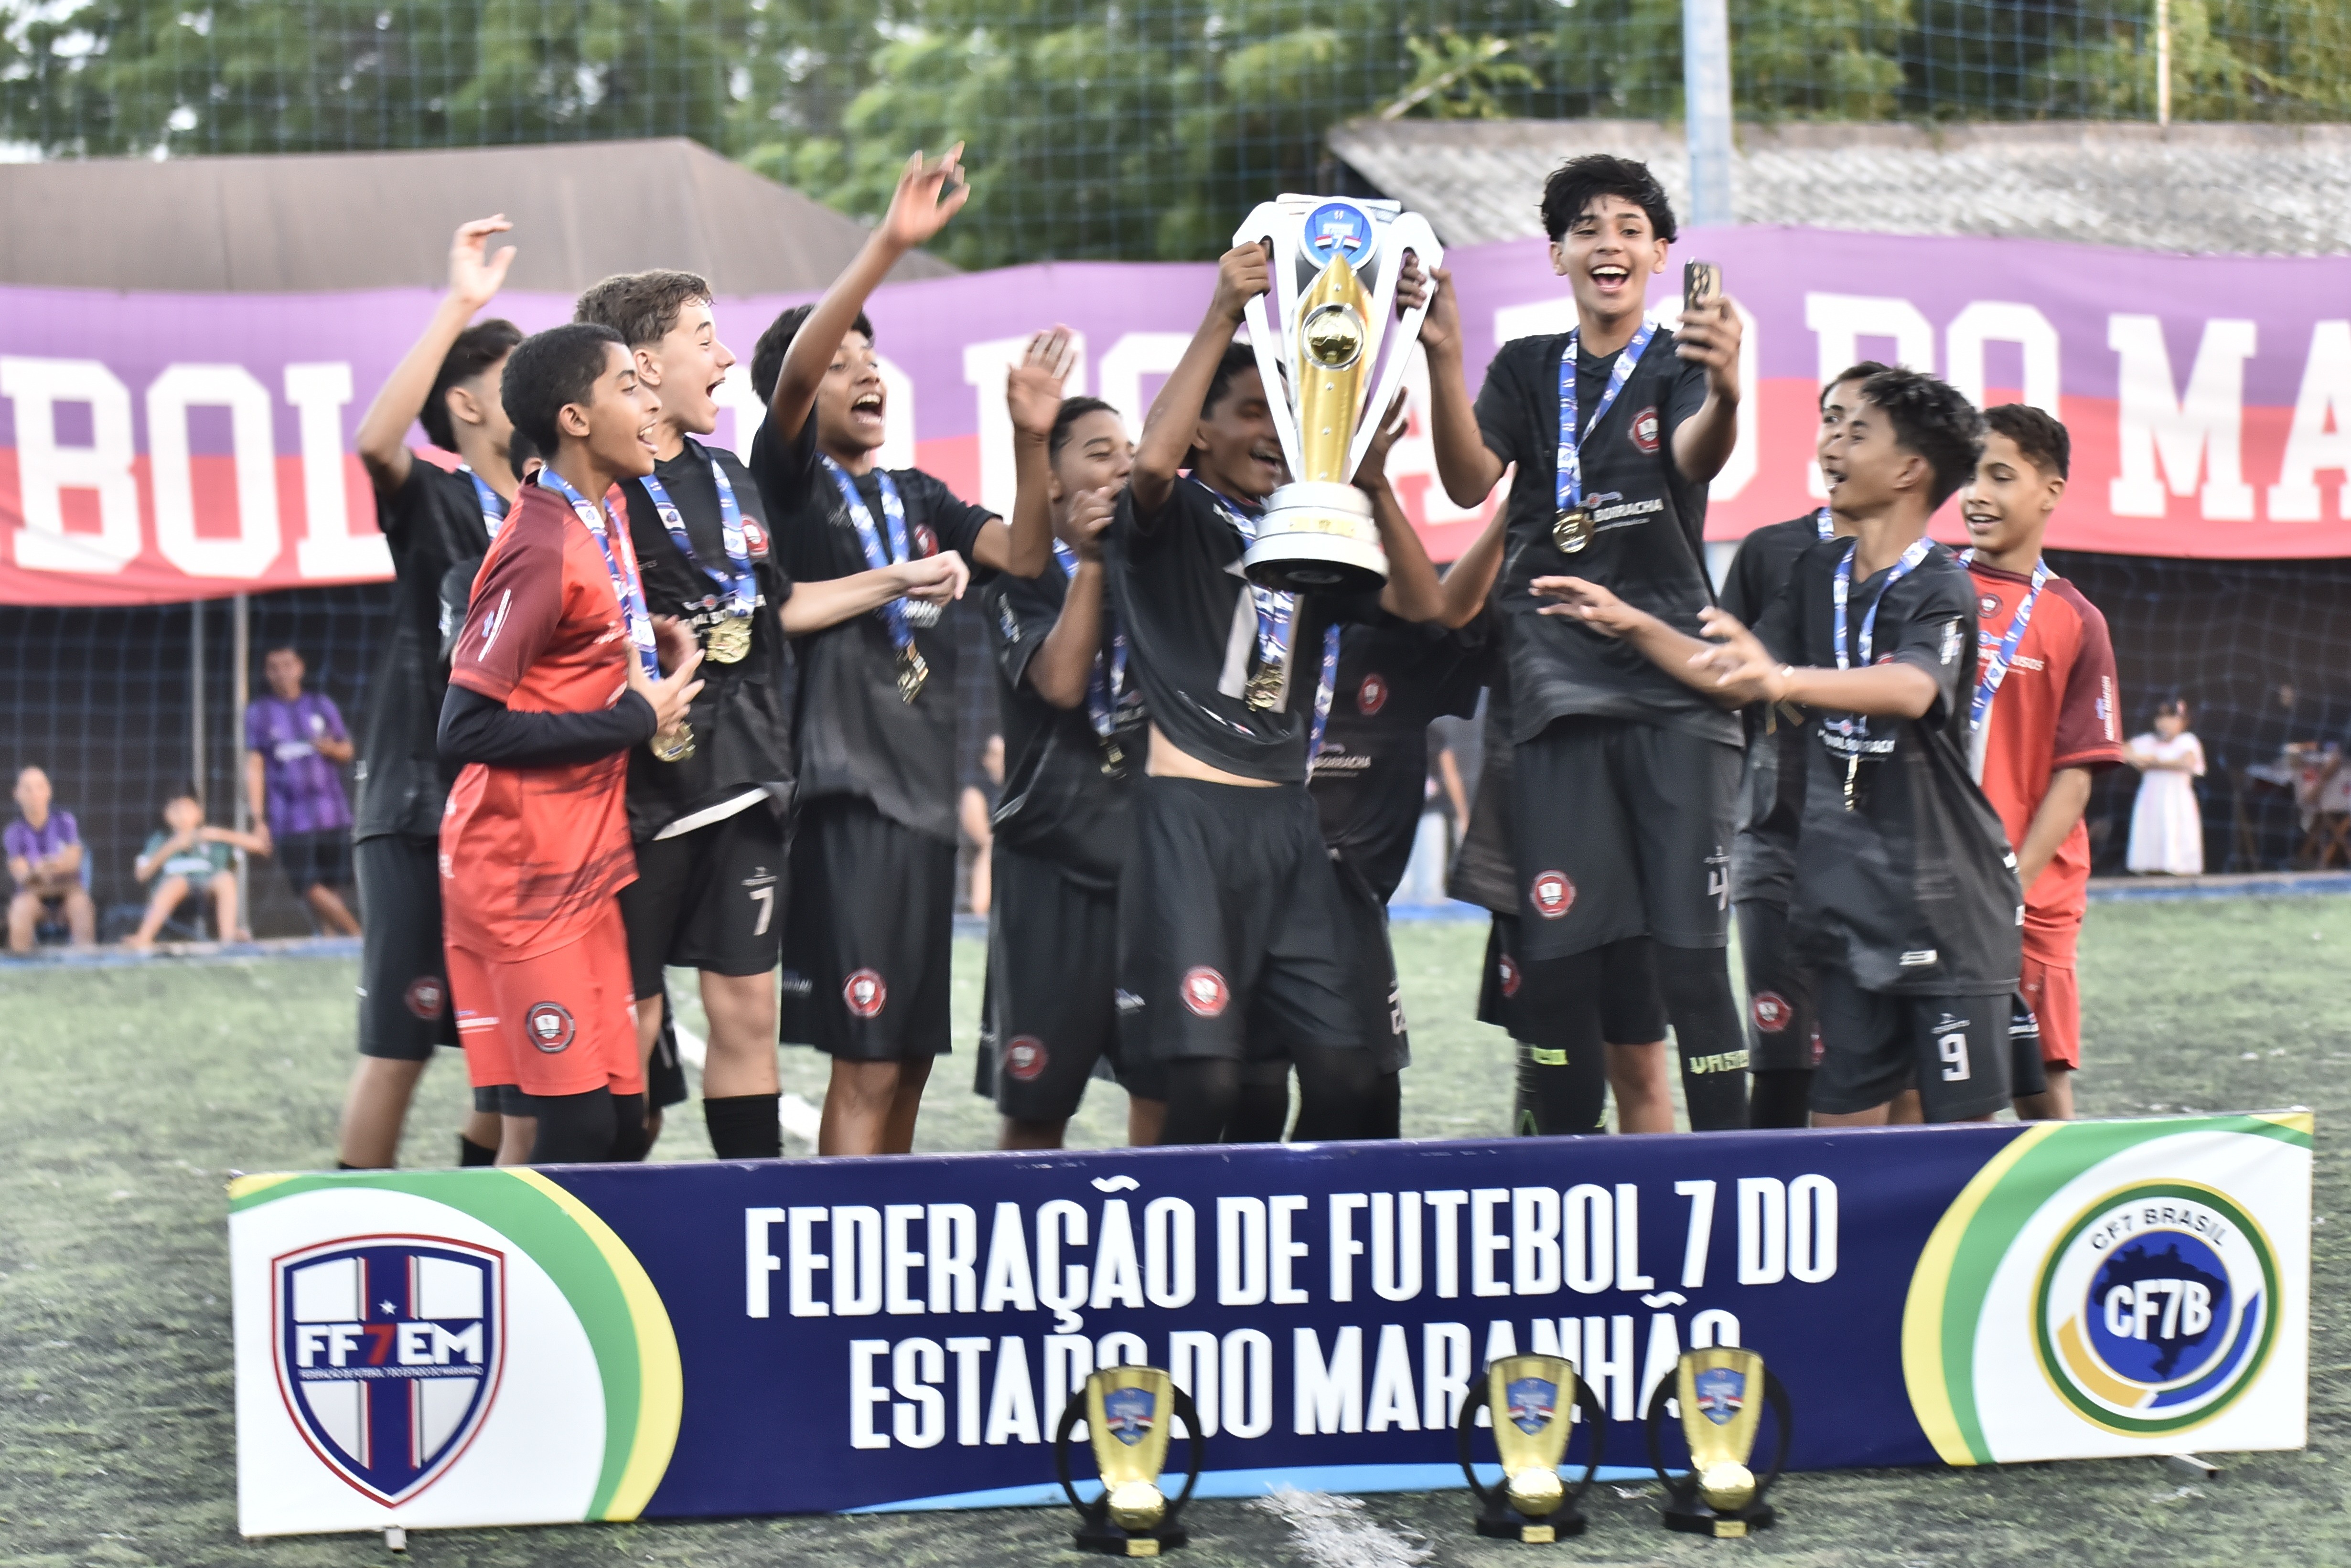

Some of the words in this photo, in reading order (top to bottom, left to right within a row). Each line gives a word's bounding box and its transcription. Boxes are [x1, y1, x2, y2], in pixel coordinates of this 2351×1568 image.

[749, 886, 774, 936] 7
[1707, 867, 1729, 911] 4
[1937, 1033, 1971, 1081] 9
[745, 1174, 1197, 1333] FEDERAÇÃO
[1216, 1195, 1310, 1306] DE
[1329, 1183, 1654, 1303] FUTEBOL
[1674, 1179, 1717, 1289] 7
[1737, 1173, 1838, 1285] DO
[2091, 1214, 2132, 1250] CF7
[2144, 1207, 2226, 1247] BRASIL
[2104, 1278, 2212, 1340] CF7B
[295, 1320, 483, 1368] FF7EM
[1169, 1327, 1273, 1440] DO
